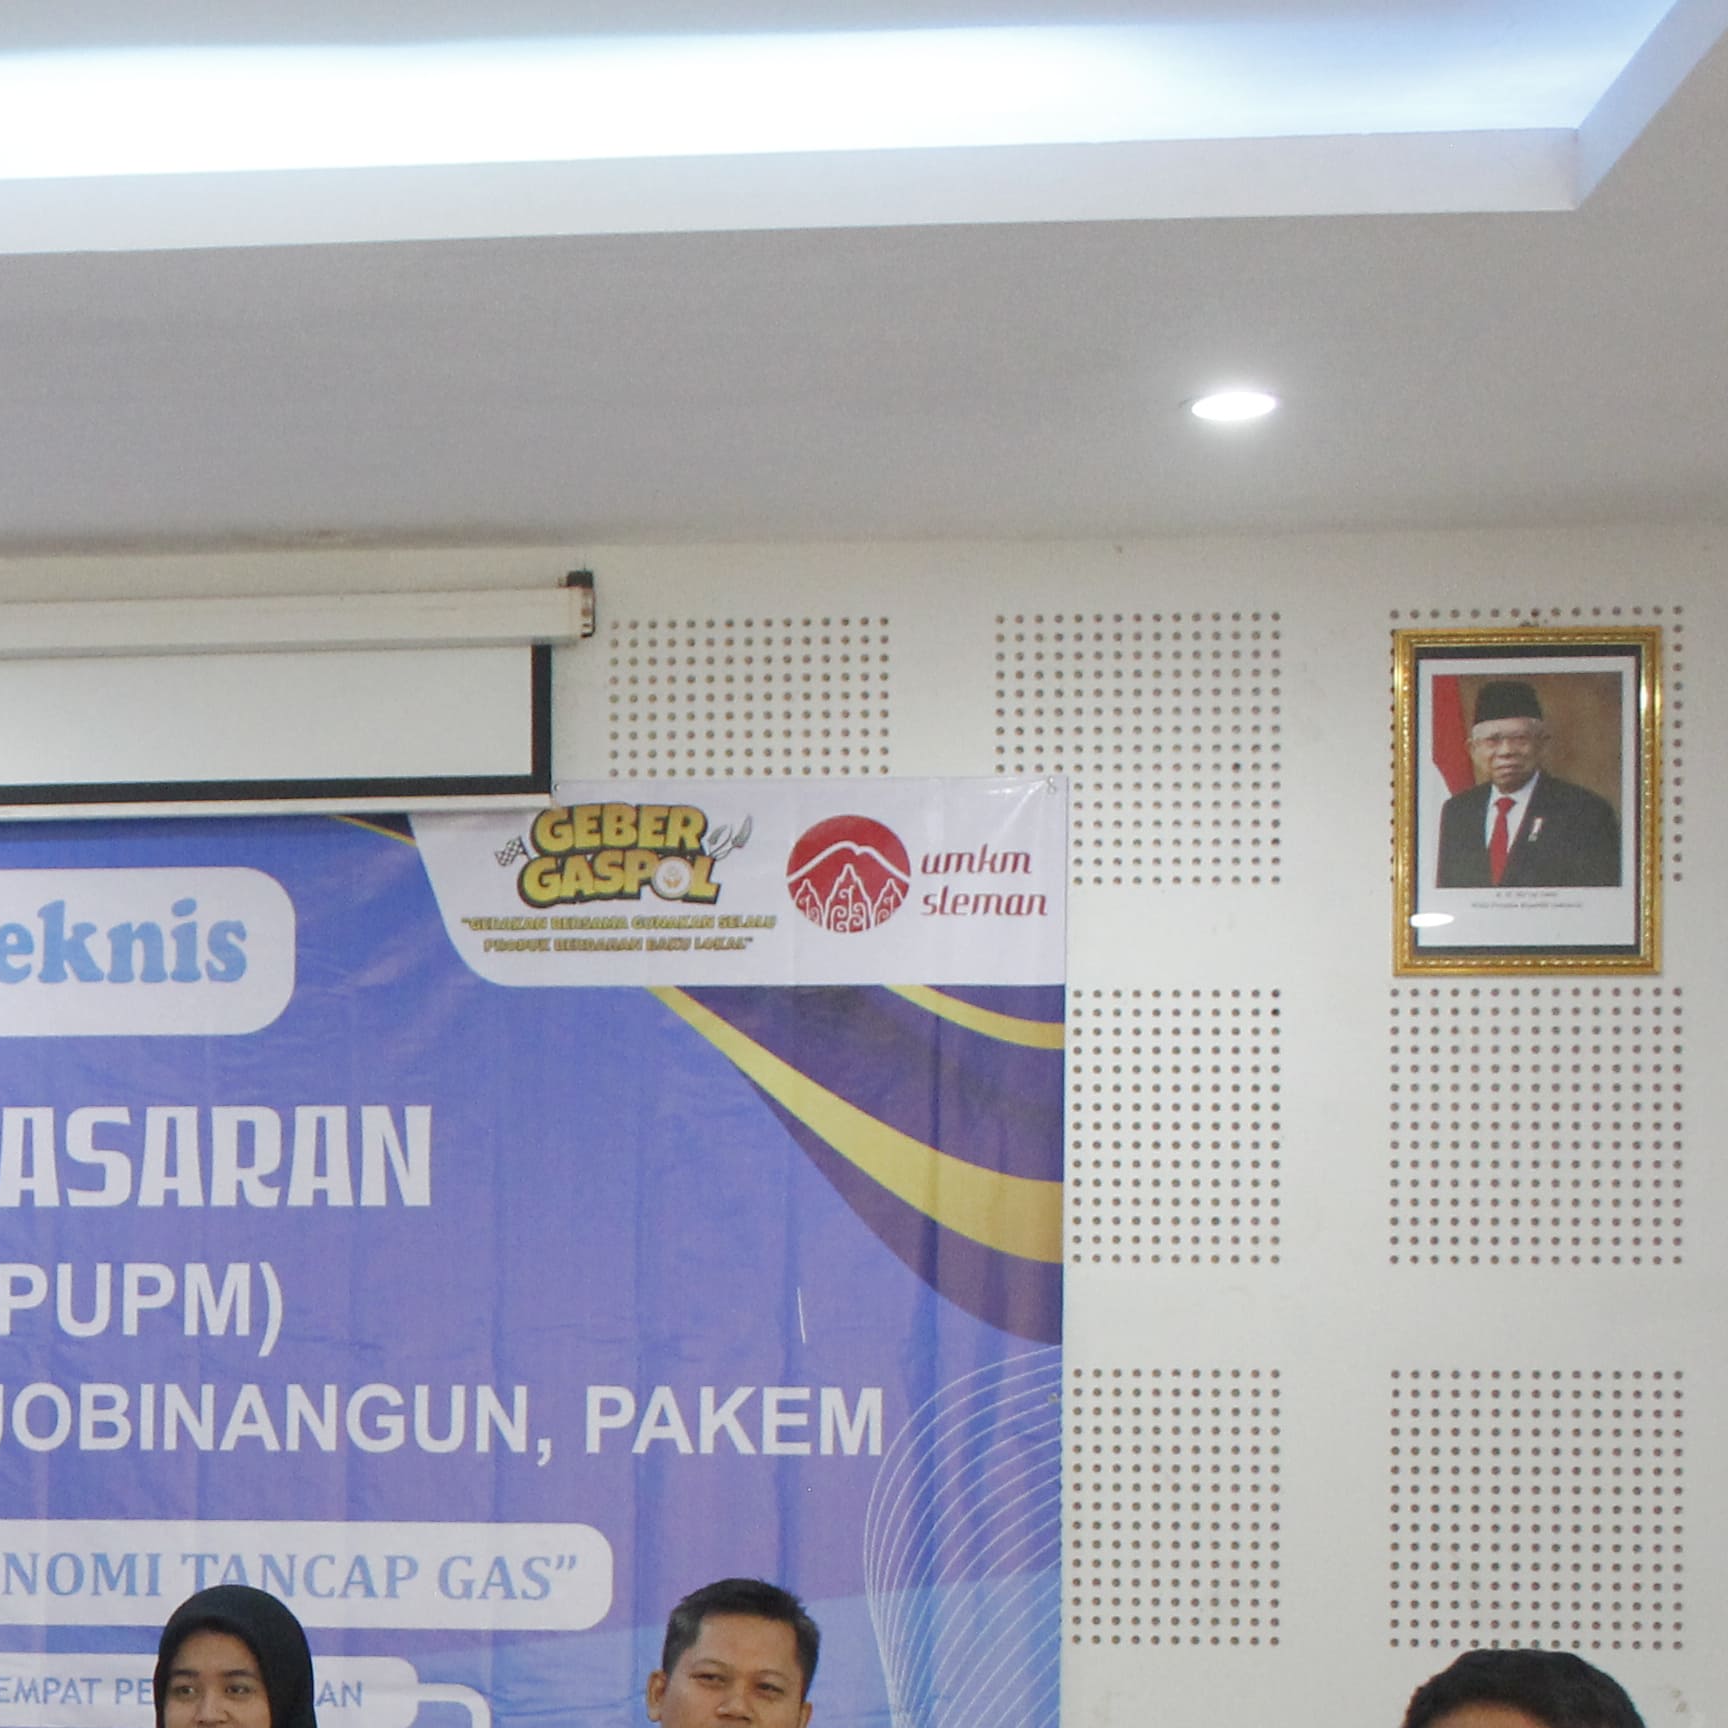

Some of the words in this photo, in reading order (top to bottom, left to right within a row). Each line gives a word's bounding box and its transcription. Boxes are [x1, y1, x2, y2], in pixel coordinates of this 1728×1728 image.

[529, 802, 707, 853] GEBER
[517, 849, 720, 907] GASPOL
[920, 843, 1033, 875] umkm
[921, 886, 1049, 917] sleman
[586, 1385, 883, 1457] PAKEM
[181, 1553, 420, 1600] TANCAP
